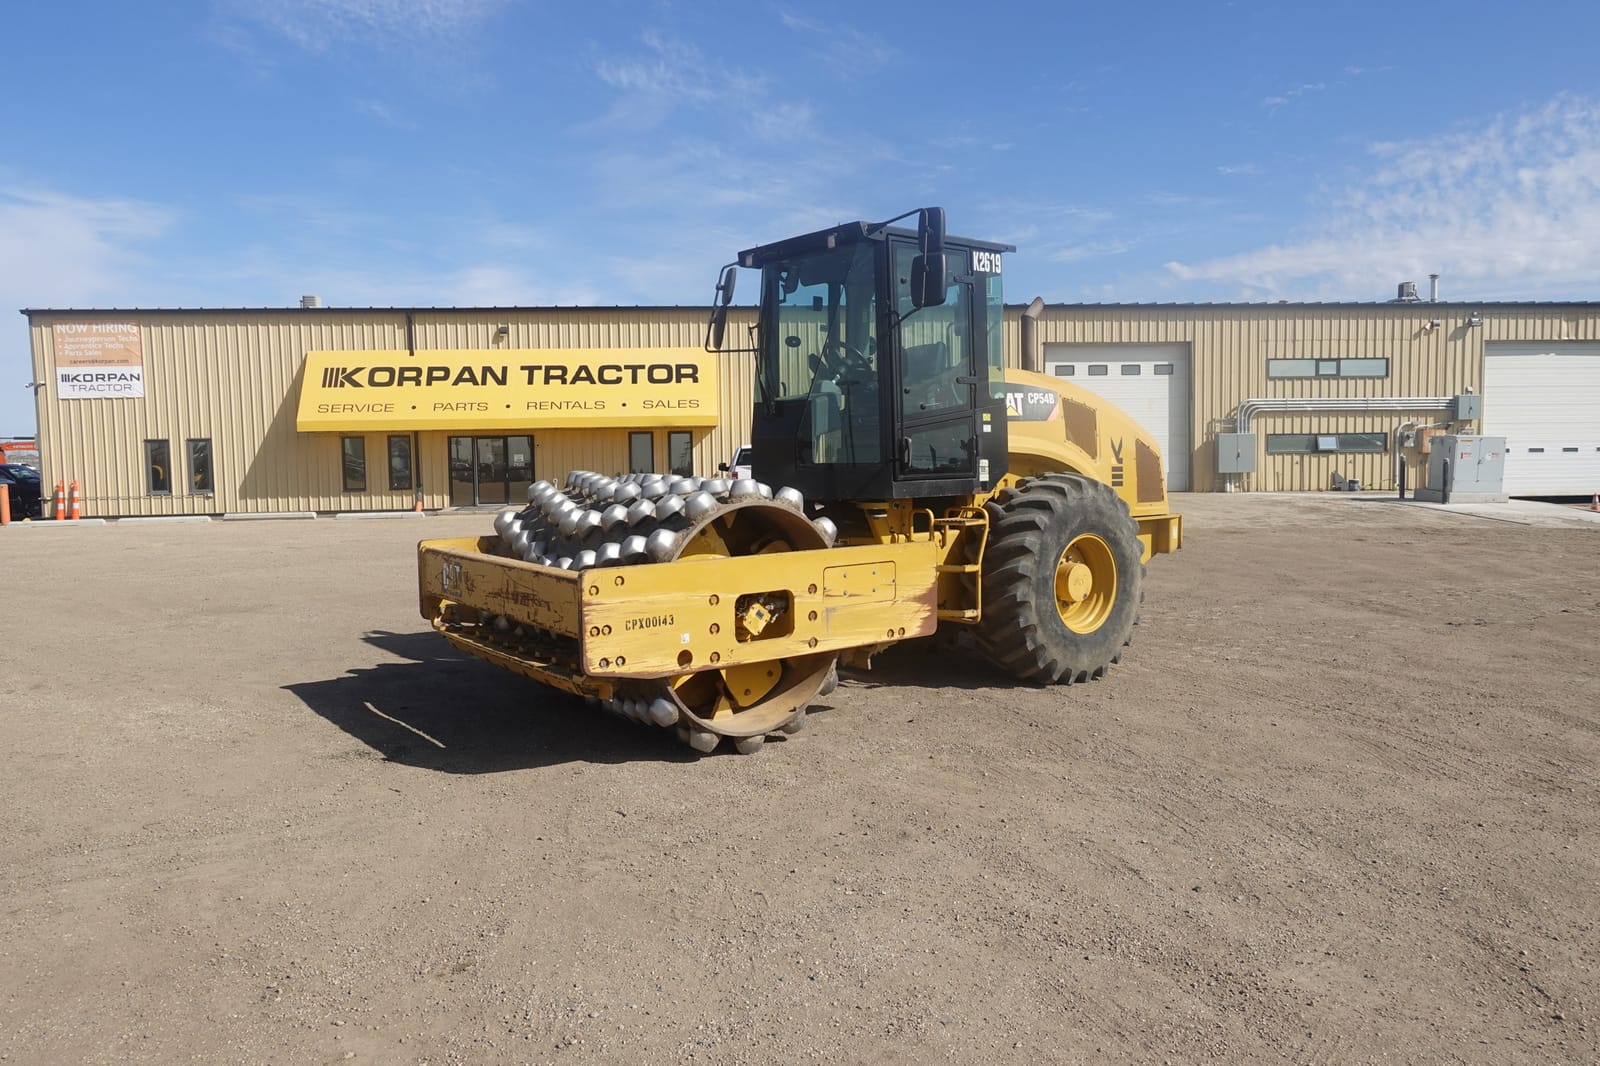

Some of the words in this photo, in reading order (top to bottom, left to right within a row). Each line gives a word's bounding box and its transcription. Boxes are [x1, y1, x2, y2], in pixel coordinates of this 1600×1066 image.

[973, 251, 1001, 273] K2619
[56, 322, 88, 334] NOW
[92, 321, 137, 333] HIRING
[61, 373, 141, 383] KORPAN
[322, 366, 508, 388] KORPAN
[520, 364, 699, 385] TRACTOR
[69, 383, 133, 392] TRACTOR
[1027, 392, 1055, 404] CP54B
[317, 403, 395, 413] SERVICE
[433, 402, 489, 412] PARTS
[526, 400, 606, 410] RENTALS
[642, 399, 700, 409] SALES
[625, 614, 675, 631] CPX00143
